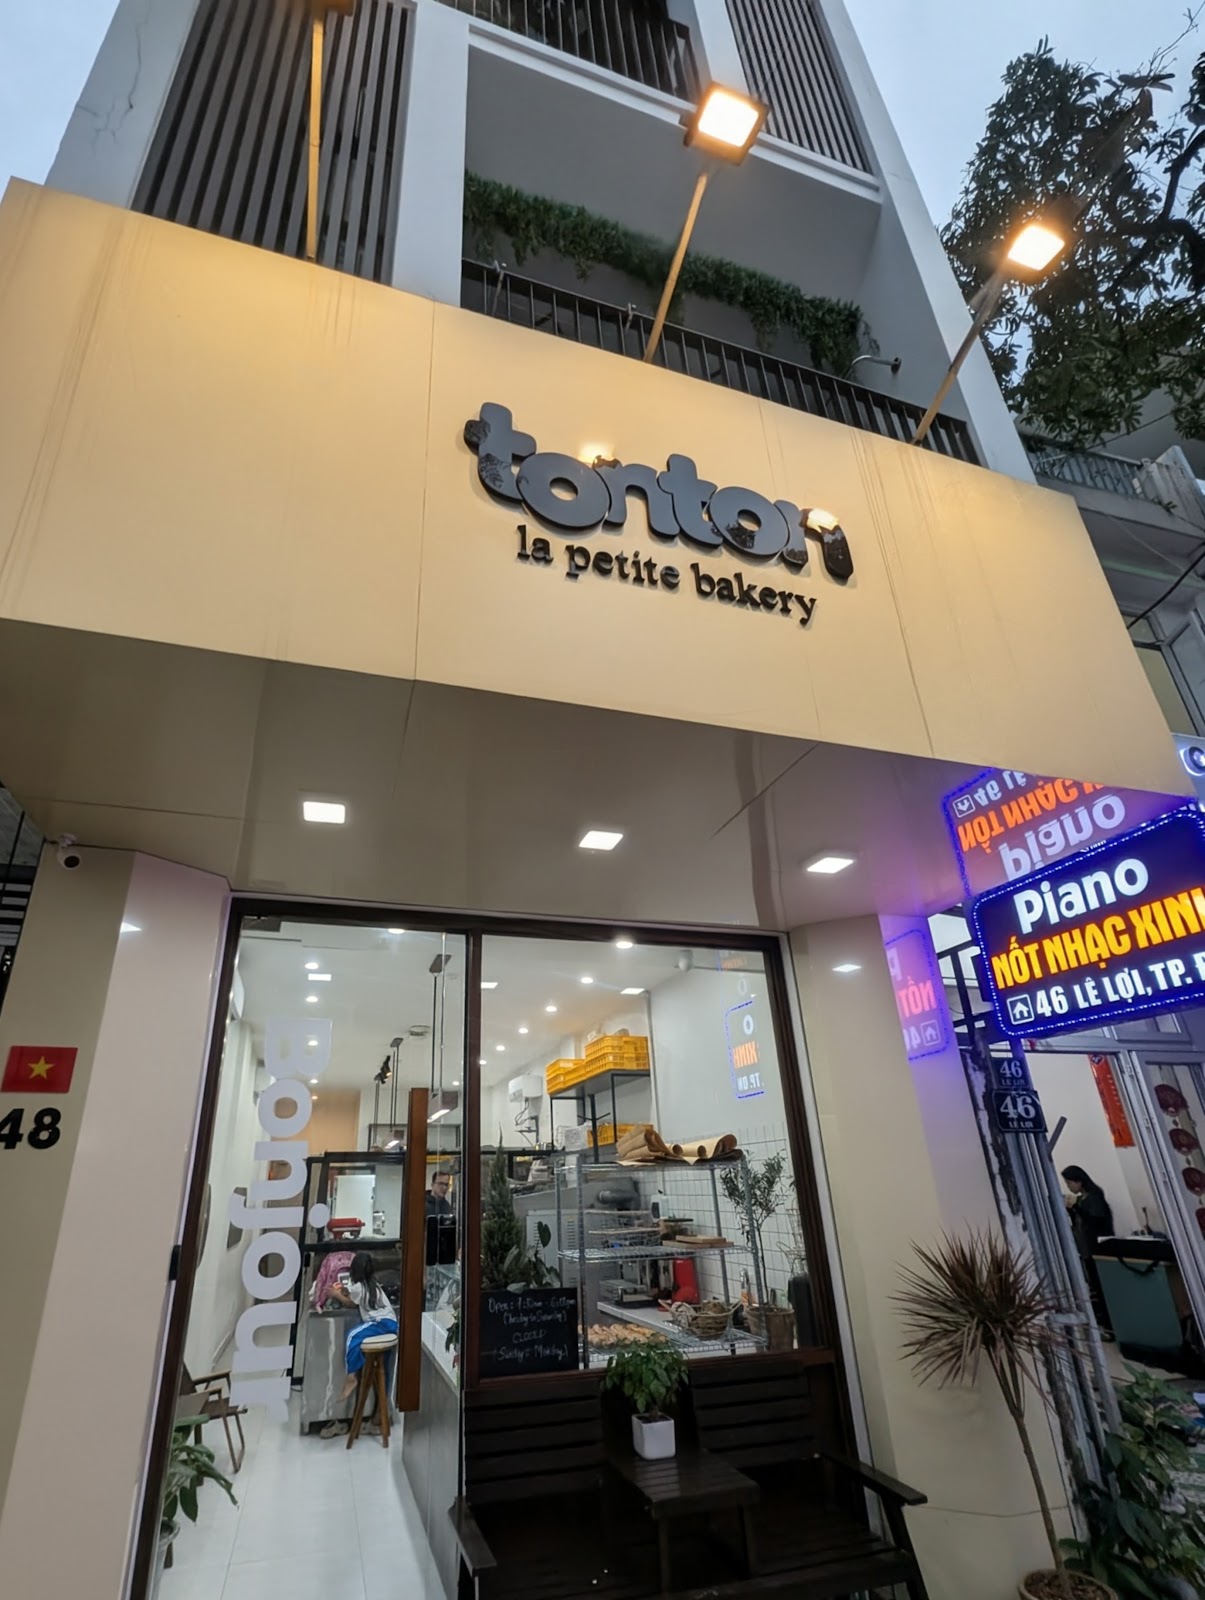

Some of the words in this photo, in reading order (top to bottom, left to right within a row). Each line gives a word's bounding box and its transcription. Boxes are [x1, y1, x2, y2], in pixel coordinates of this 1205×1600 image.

[463, 402, 854, 584] tonton
[516, 525, 553, 562] la
[565, 544, 680, 589] petite
[690, 563, 817, 624] bakery
[1013, 859, 1148, 934] Piano
[991, 936, 1043, 989] NỐT
[1042, 915, 1131, 969] NHẠC
[1036, 985, 1069, 1017] 46
[1073, 977, 1102, 1009] LÊ
[1102, 968, 1152, 1003] LỢI,
[1148, 959, 1193, 991] TP.
[1000, 1060, 1023, 1078] 46
[0, 1107, 61, 1149] 48
[1000, 1096, 1036, 1119] 46
[227, 1018, 332, 1423] Bonjour
